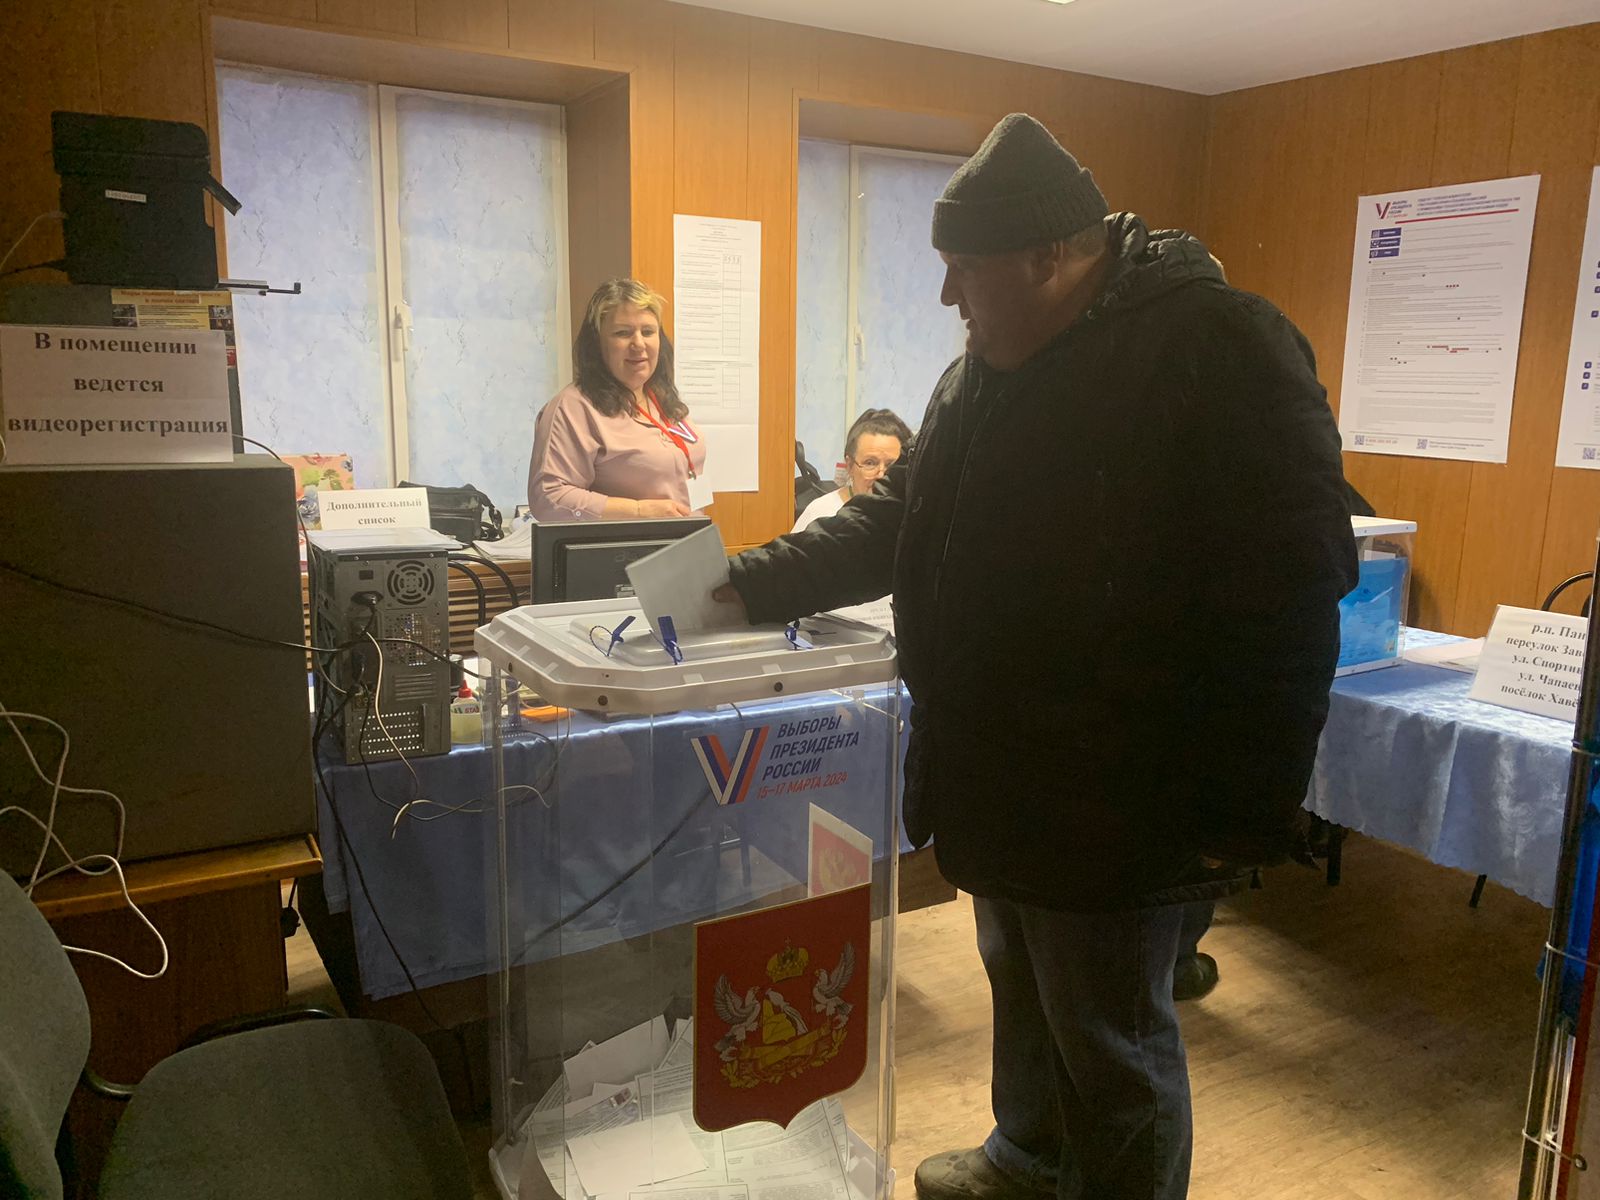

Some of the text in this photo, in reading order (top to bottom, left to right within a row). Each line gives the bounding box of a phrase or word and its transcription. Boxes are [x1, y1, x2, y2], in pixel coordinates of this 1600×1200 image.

[34, 332, 198, 356] В помещении
[73, 375, 164, 393] ведется
[8, 416, 229, 437] видеорегистрация
[326, 498, 422, 512] Дополнительный
[358, 516, 396, 525] список
[1506, 637, 1585, 657] переулок Зав
[1512, 655, 1529, 664] ул.
[1518, 672, 1535, 682] ул.
[1501, 685, 1546, 700] посёлок
[777, 715, 842, 739] ВЫБОРЫ
[770, 731, 860, 760] ПРЕЗИДЕНТА
[762, 756, 823, 781] РОССИИ
[787, 776, 822, 793] МАРТА
[823, 771, 849, 787] 2024
